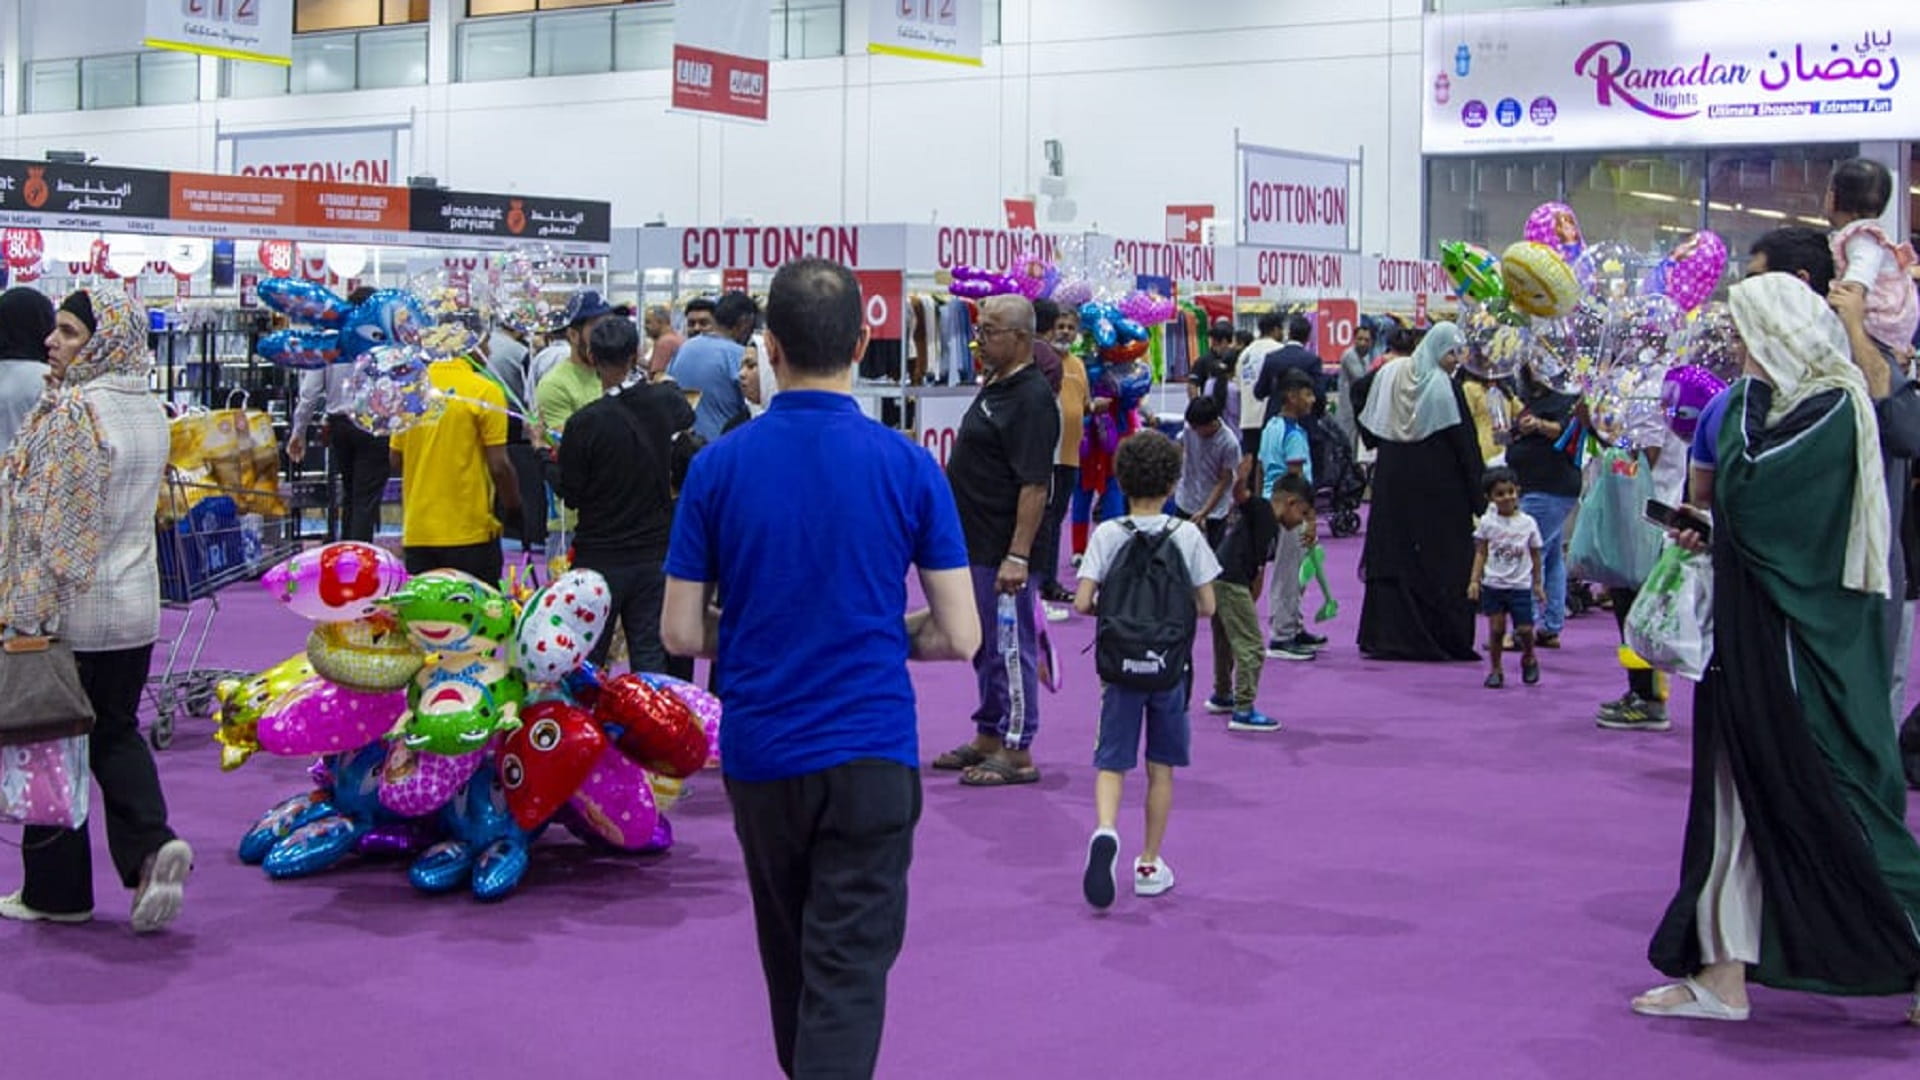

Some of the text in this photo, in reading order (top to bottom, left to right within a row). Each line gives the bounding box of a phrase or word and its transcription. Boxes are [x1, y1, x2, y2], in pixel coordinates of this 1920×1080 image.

[1574, 39, 1752, 119] Ramadan
[1760, 43, 1900, 91] رمضان
[1654, 90, 1698, 109] Nights
[1249, 180, 1345, 225] COTTON:ON
[682, 226, 858, 268] COTTON:ON
[1115, 240, 1215, 281] COTTON:ON
[1258, 251, 1342, 288] COTTON:ON
[1379, 259, 1449, 293] COTTON:ON
[1326, 319, 1352, 346] 10
